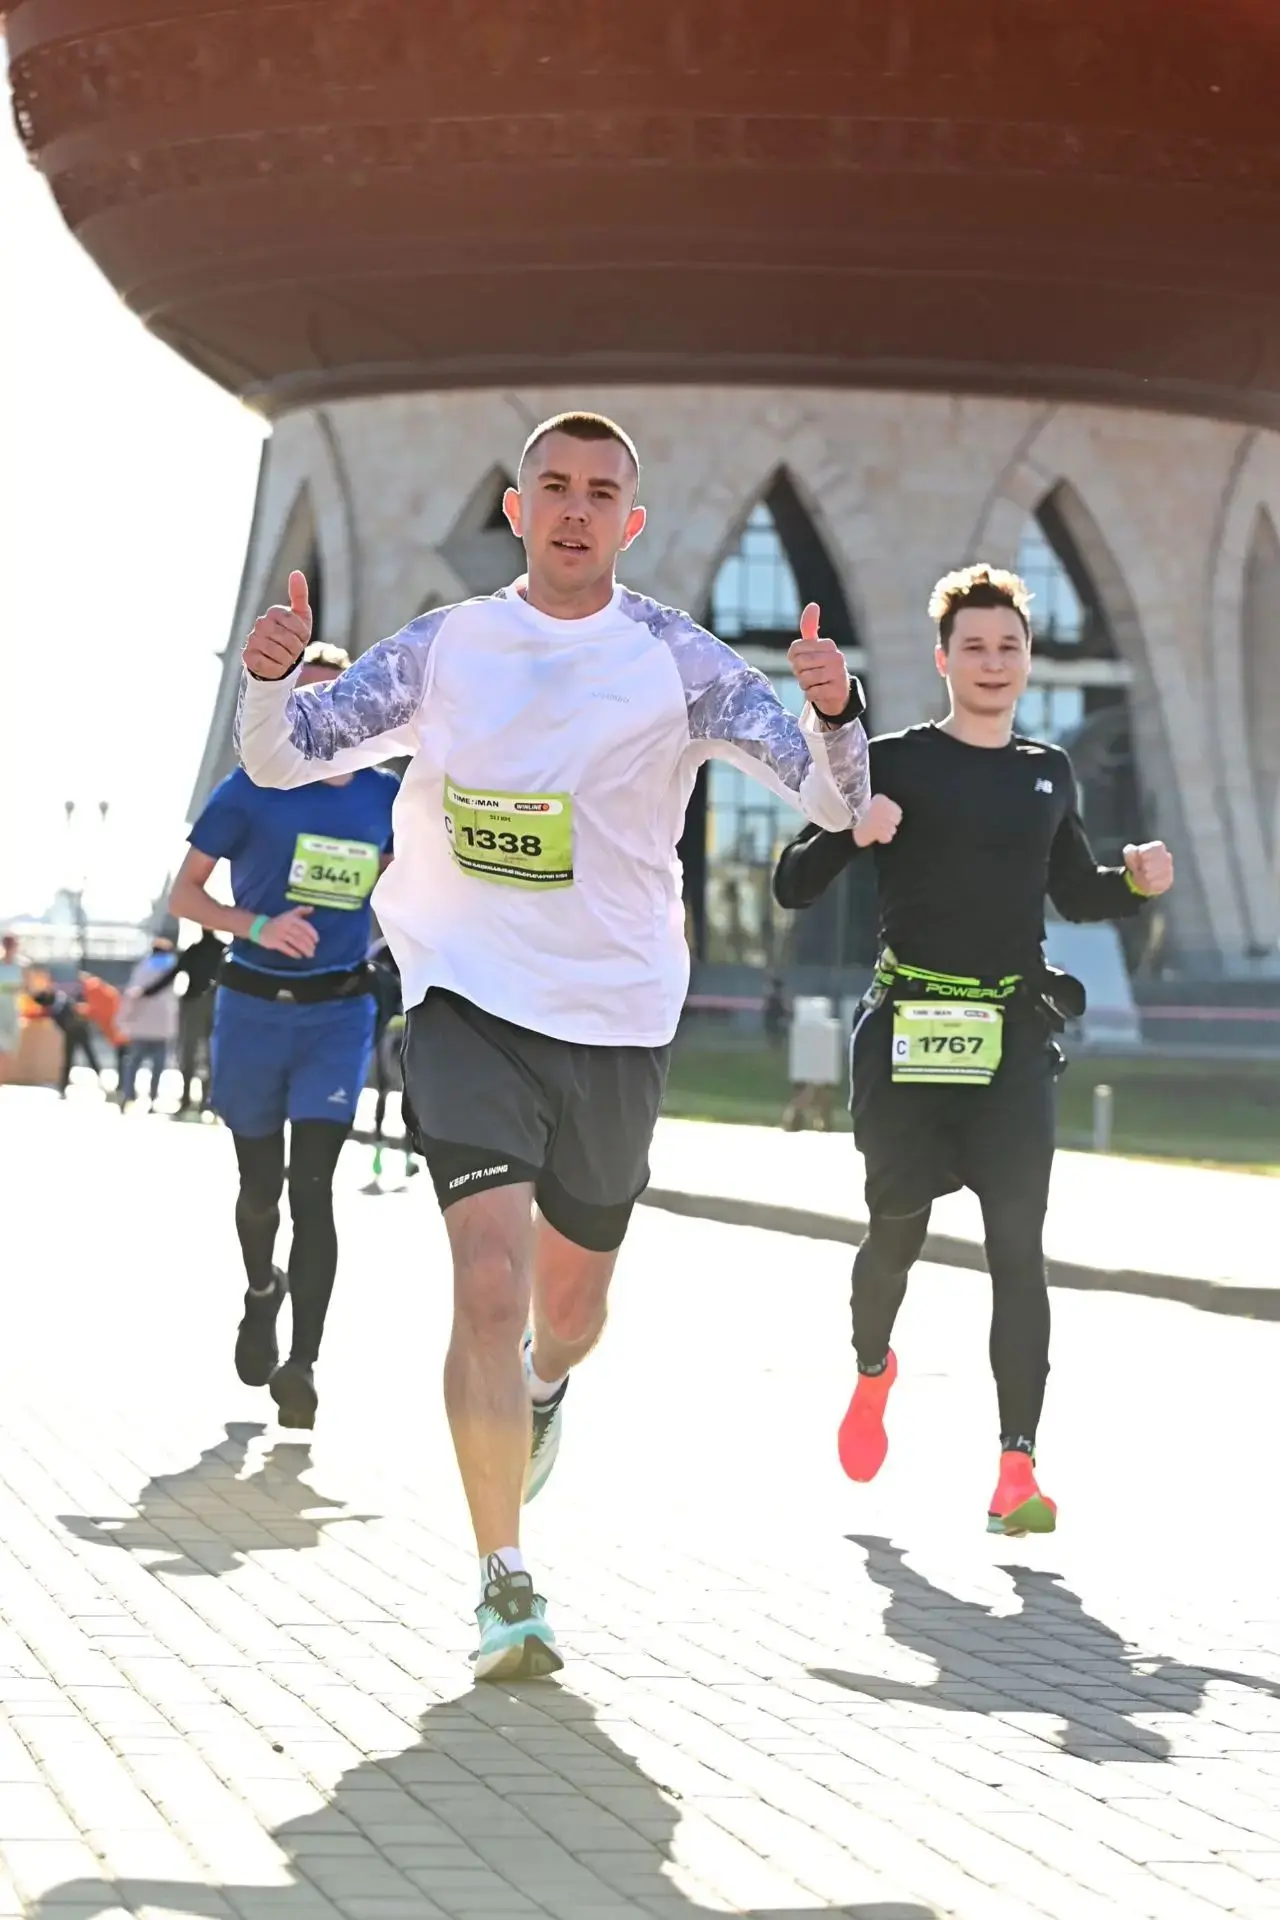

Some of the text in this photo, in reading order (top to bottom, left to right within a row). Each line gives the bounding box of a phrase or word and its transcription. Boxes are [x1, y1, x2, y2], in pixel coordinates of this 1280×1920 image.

[461, 826, 542, 857] 1338
[311, 864, 360, 887] 3441
[926, 982, 1016, 999] POWERUP
[896, 1036, 984, 1055] C 1767
[449, 1164, 509, 1190] KEEP TRAINING
